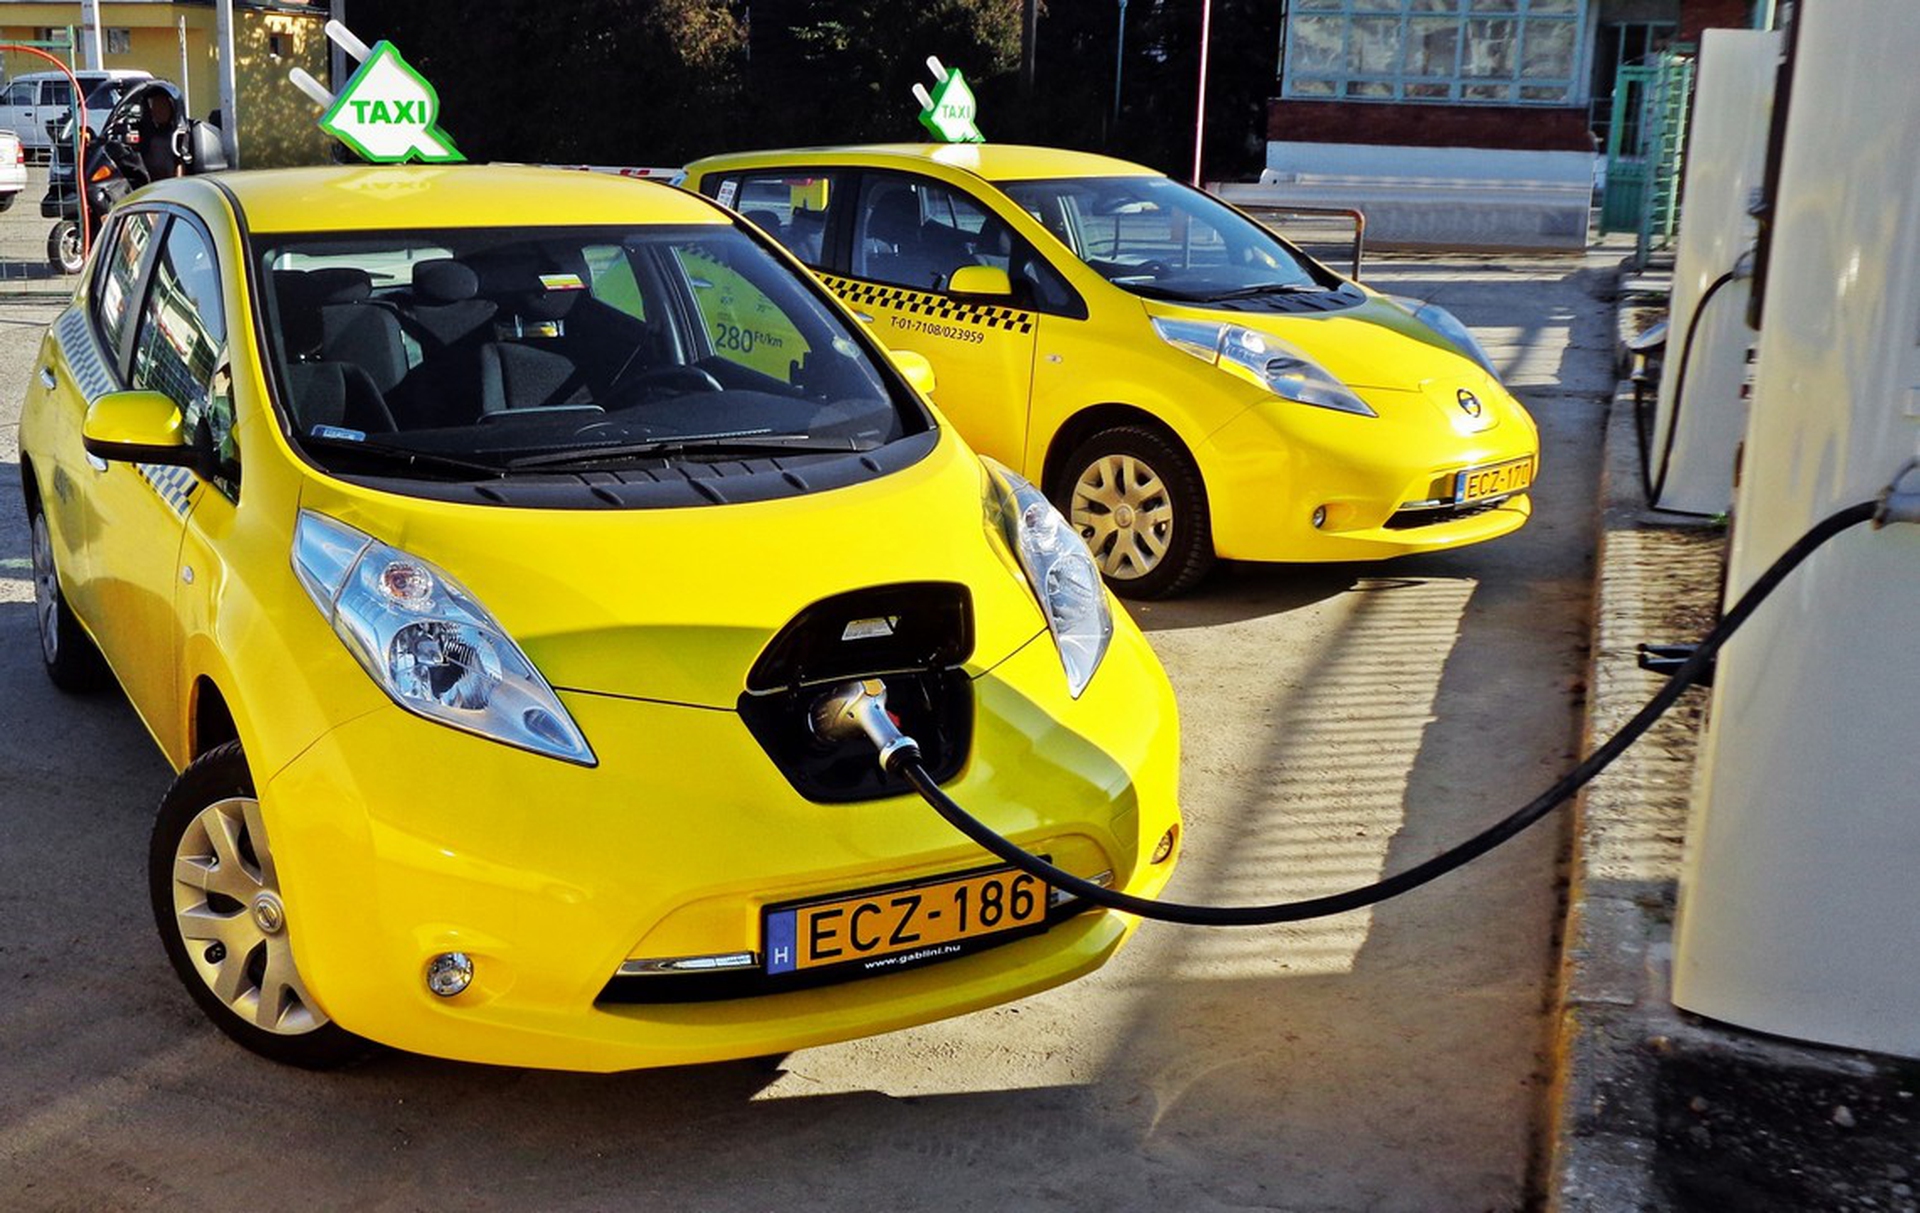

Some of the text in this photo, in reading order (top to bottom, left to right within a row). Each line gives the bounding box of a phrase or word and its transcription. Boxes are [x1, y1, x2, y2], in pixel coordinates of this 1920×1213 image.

[349, 100, 427, 125] TAXI
[941, 104, 971, 119] TAXI
[1467, 462, 1530, 498] ECZ-170
[810, 874, 1035, 961] ECZ-186
[773, 946, 789, 965] H
[864, 944, 961, 969] www.gablini.hu
